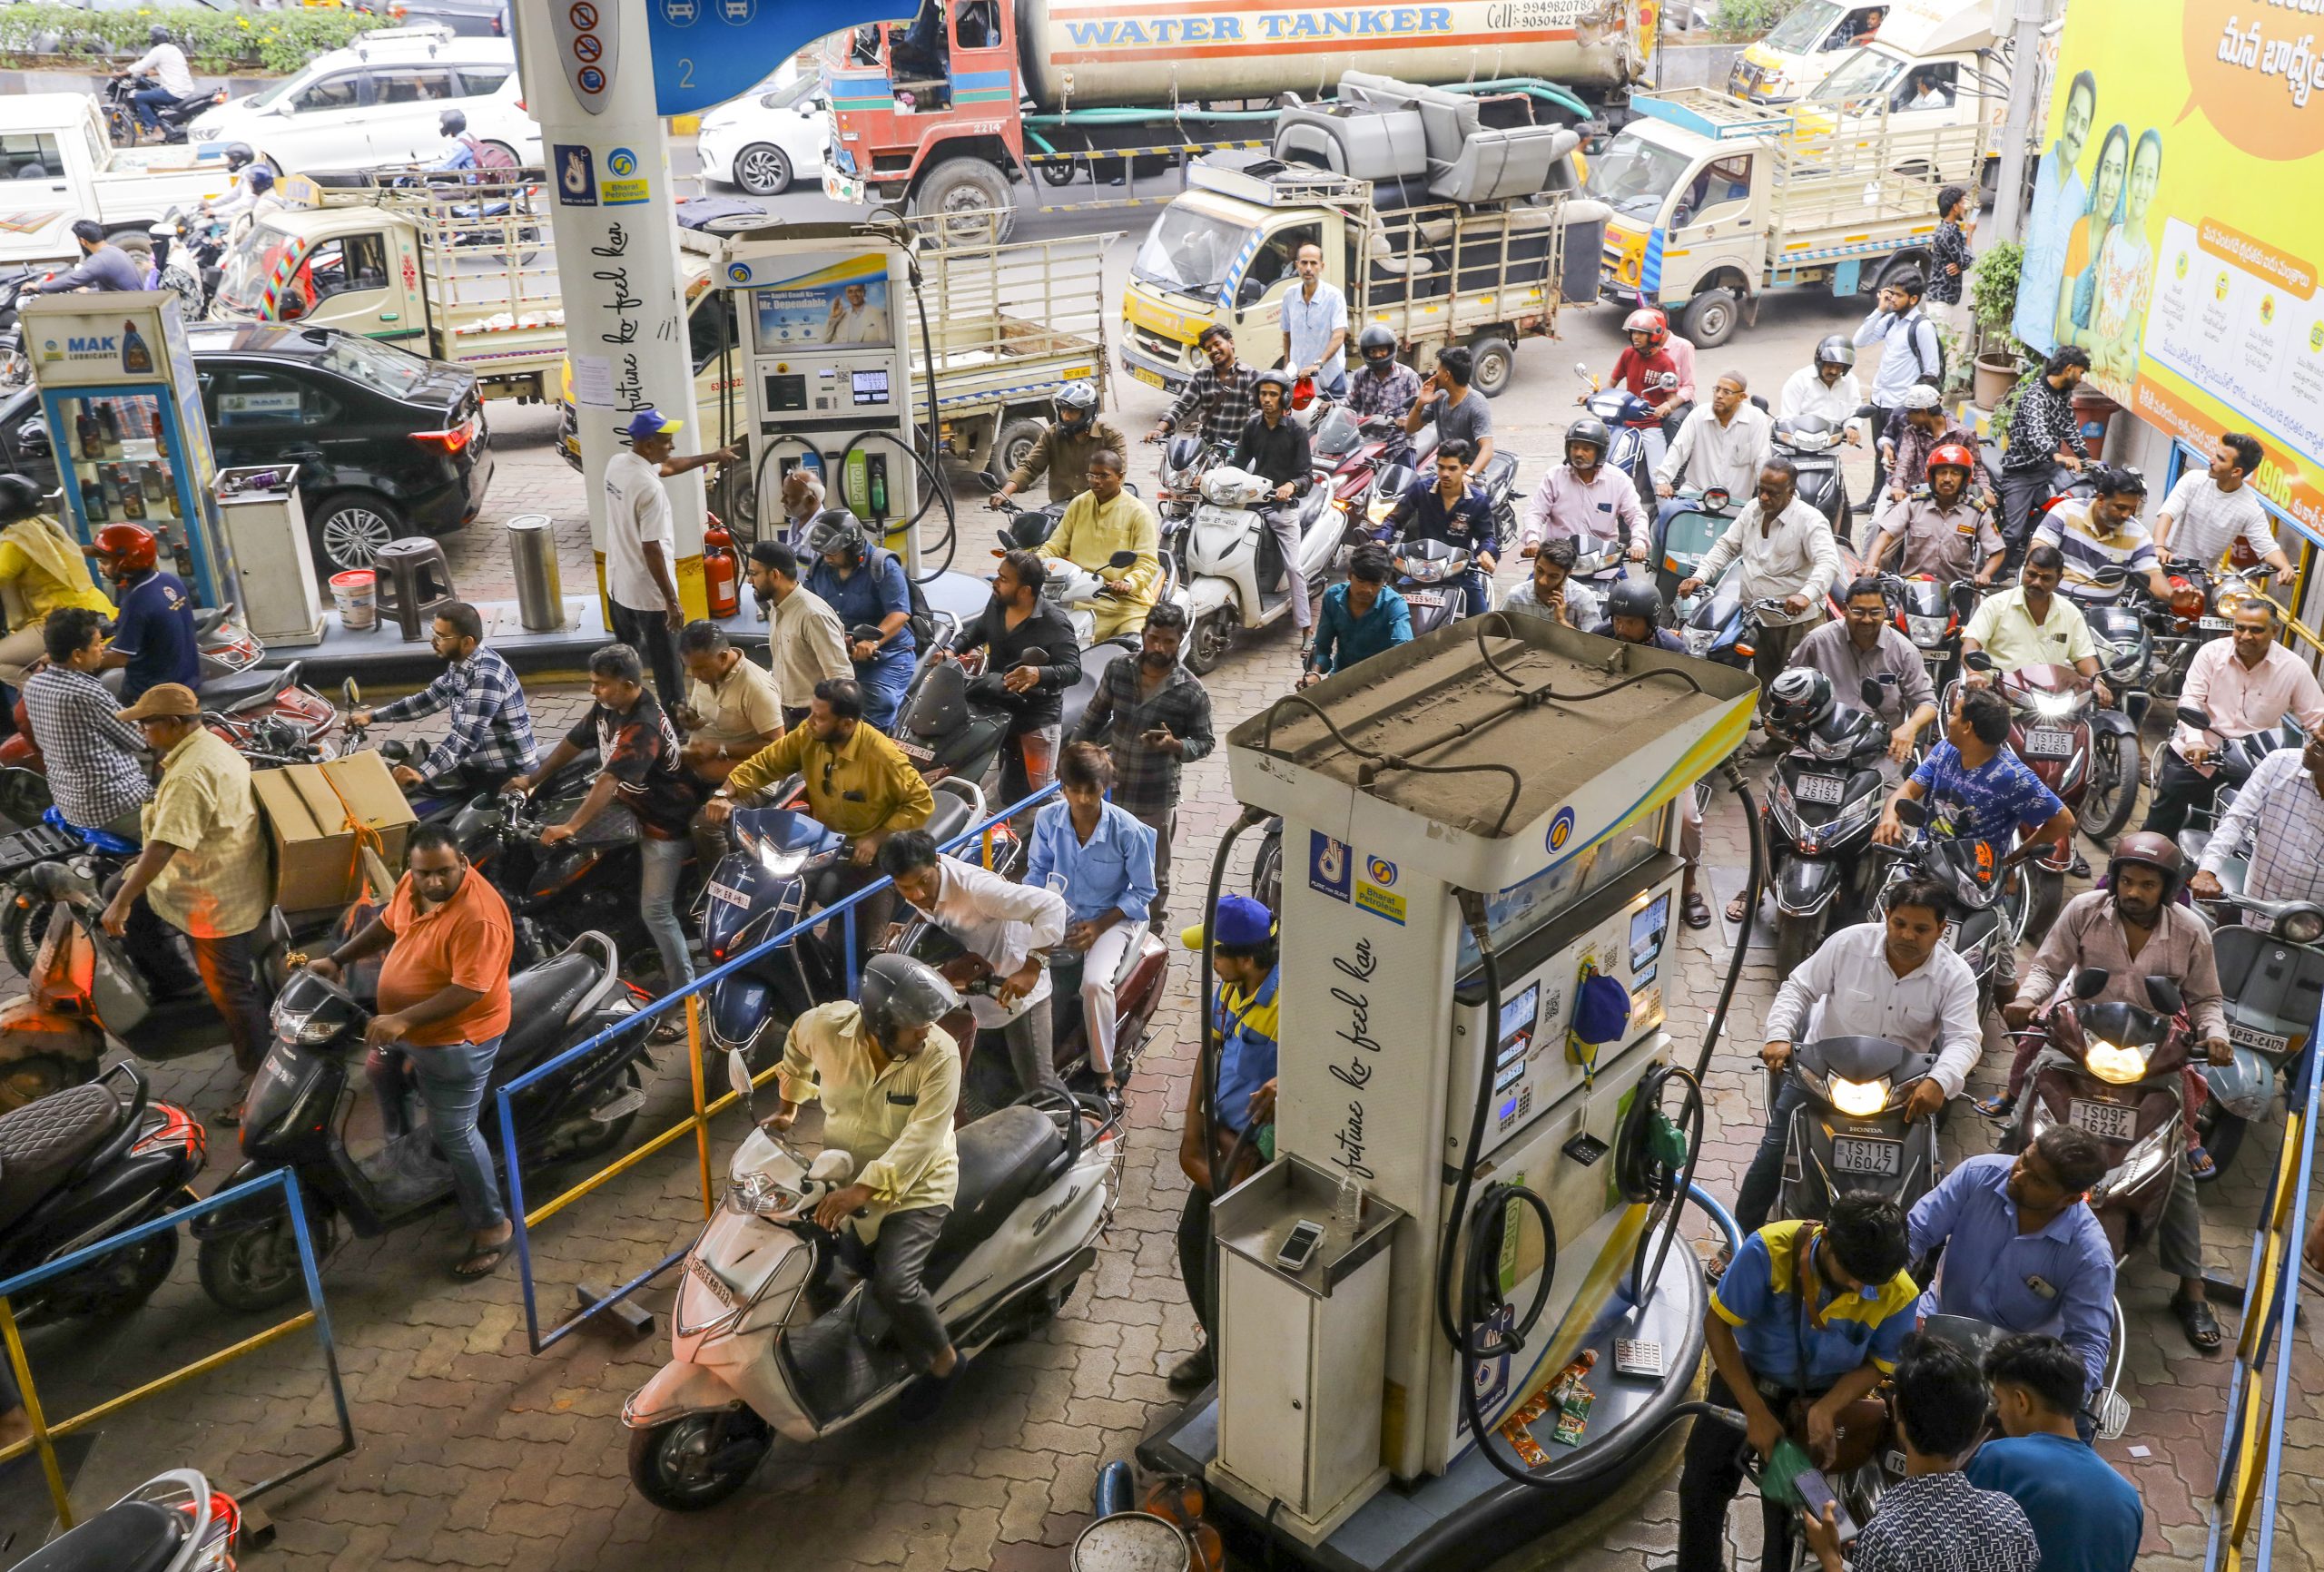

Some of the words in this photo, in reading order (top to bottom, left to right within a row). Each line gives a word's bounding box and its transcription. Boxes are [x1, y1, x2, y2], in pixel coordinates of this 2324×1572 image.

[1065, 16, 1246, 47] WATER
[1257, 6, 1454, 41] TANKER
[2217, 15, 2261, 69] మన
[678, 58, 695, 88] 2
[974, 123, 1001, 133] 2214
[605, 190, 646, 198] Petroleum
[591, 221, 628, 256] kar
[593, 268, 642, 315] feel
[759, 301, 772, 310] Mr.
[774, 299, 827, 309] Dependable
[602, 319, 638, 345] ko
[68, 337, 116, 352] MAK
[69, 352, 118, 360] LUBRICANTS
[615, 353, 655, 412] future
[852, 465, 866, 504] Petrol
[2255, 457, 2293, 510] 1906
[2201, 619, 2212, 627] TS
[2034, 732, 2067, 744] TS13E
[1803, 786, 1837, 801] Z6194
[1806, 776, 1839, 791] TS12E
[1359, 892, 1403, 916] Petroleum
[1366, 888, 1395, 905] Bharat
[1333, 937, 1376, 982] kar
[1331, 987, 1381, 1052] feel
[1329, 1056, 1372, 1090] ko
[2093, 1095, 2121, 1103] HONDA
[2082, 1104, 2129, 1124] TS09F
[2081, 1117, 2127, 1138] T6234
[1331, 1100, 1374, 1180] future
[1846, 1141, 1893, 1159] TS11E
[1846, 1154, 1892, 1172] V6047
[1893, 1456, 1905, 1473] TS
